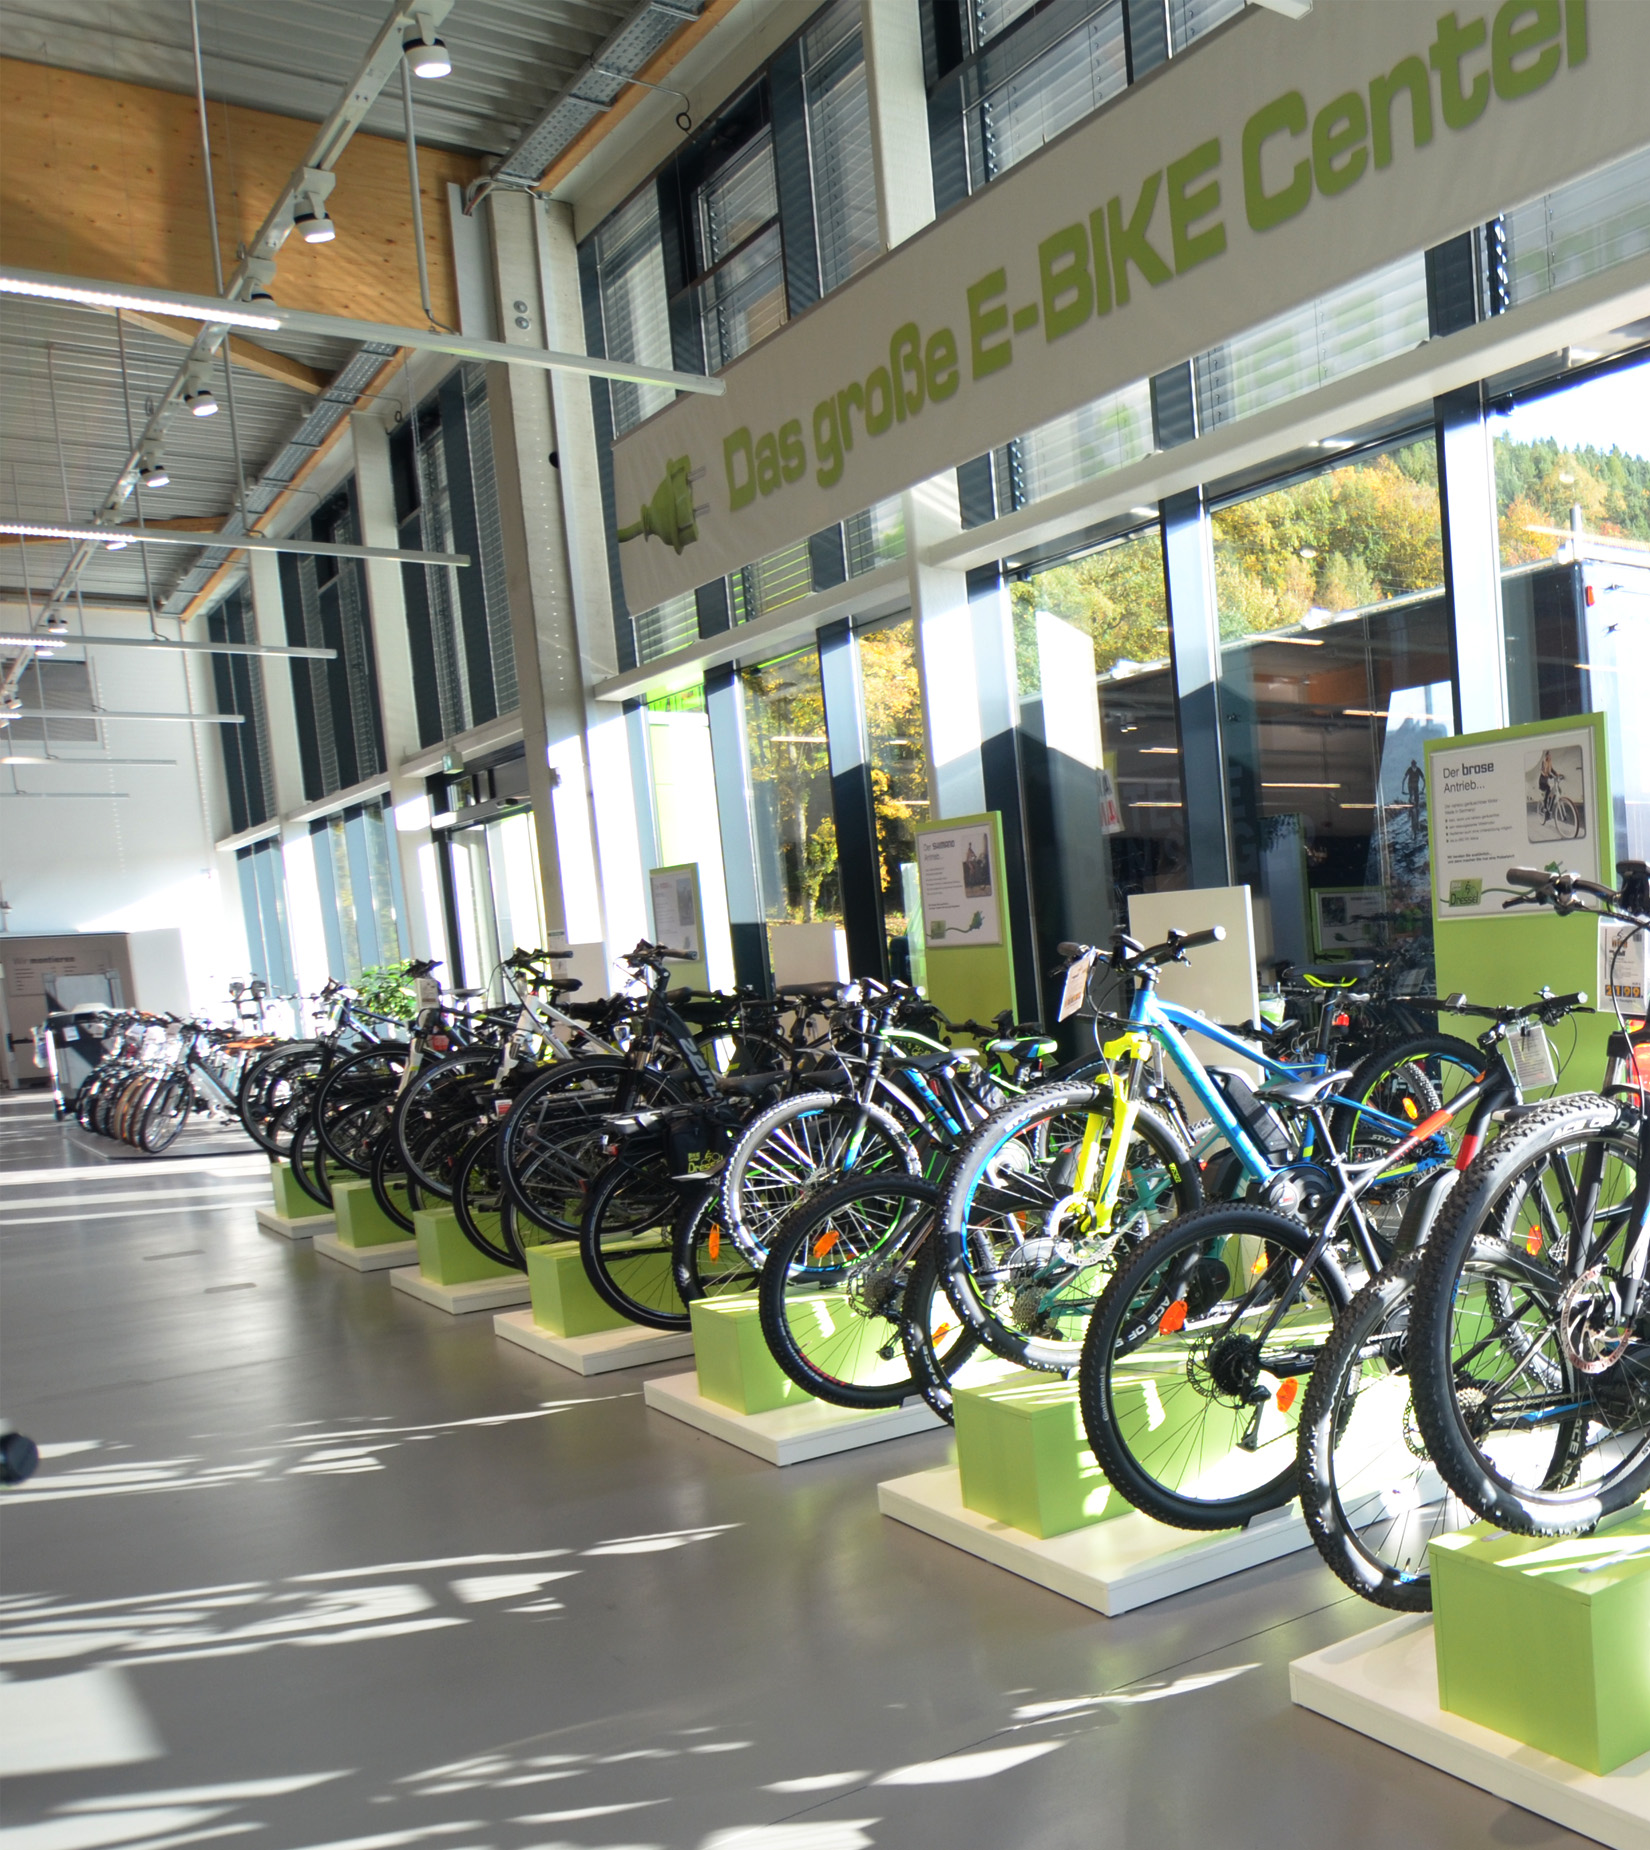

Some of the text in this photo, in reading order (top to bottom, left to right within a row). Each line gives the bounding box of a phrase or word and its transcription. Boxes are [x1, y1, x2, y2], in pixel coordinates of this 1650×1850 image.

[723, 419, 807, 512] Das
[812, 322, 960, 489] große
[966, 136, 1228, 382] E-BIKE
[1443, 762, 1495, 779] Der brose
[1444, 780, 1485, 794] Antrieb...
[1128, 1296, 1170, 1342] ACE OF
[1569, 1418, 1583, 1455] ACE
